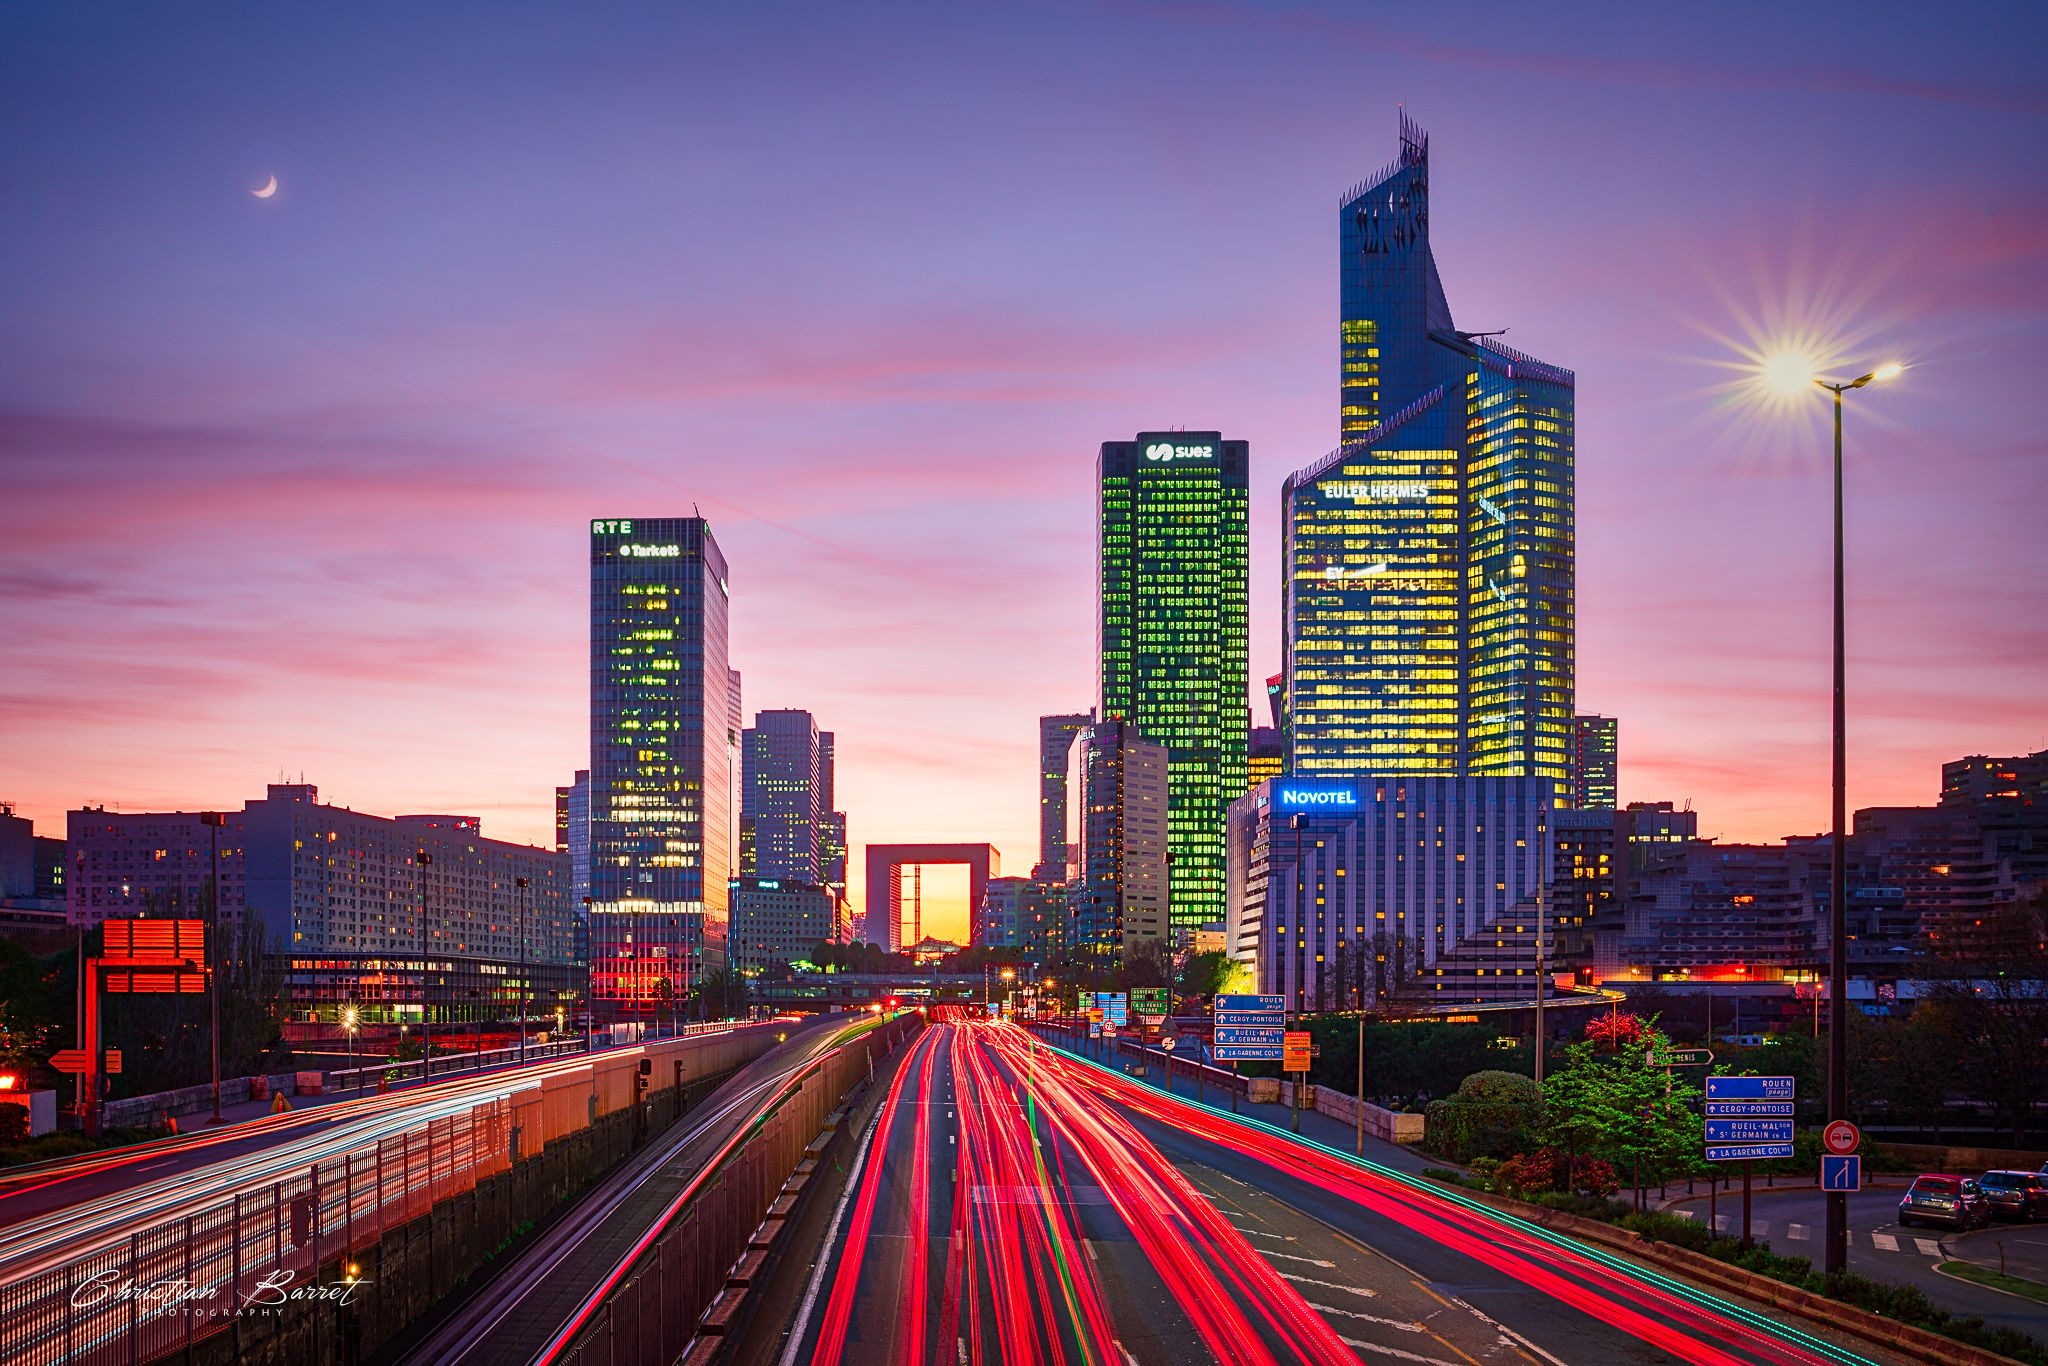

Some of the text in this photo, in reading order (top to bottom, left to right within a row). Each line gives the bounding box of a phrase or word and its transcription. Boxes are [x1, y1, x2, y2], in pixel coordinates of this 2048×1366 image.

[1175, 446, 1212, 458] suez
[1325, 485, 1429, 498] EULER HERMES
[593, 521, 632, 534] RTE
[632, 544, 680, 557] Tarkett
[1326, 567, 1345, 580] EY
[1283, 790, 1356, 804] NOVOTEL
[1229, 1015, 1282, 1023] CERGY-PONTOISE
[1720, 1105, 1791, 1113] CERGY-PONTOISE
[1731, 1131, 1769, 1139] GERMAIN
[1720, 1149, 1730, 1157] LA
[1732, 1147, 1766, 1156] GARENNE
